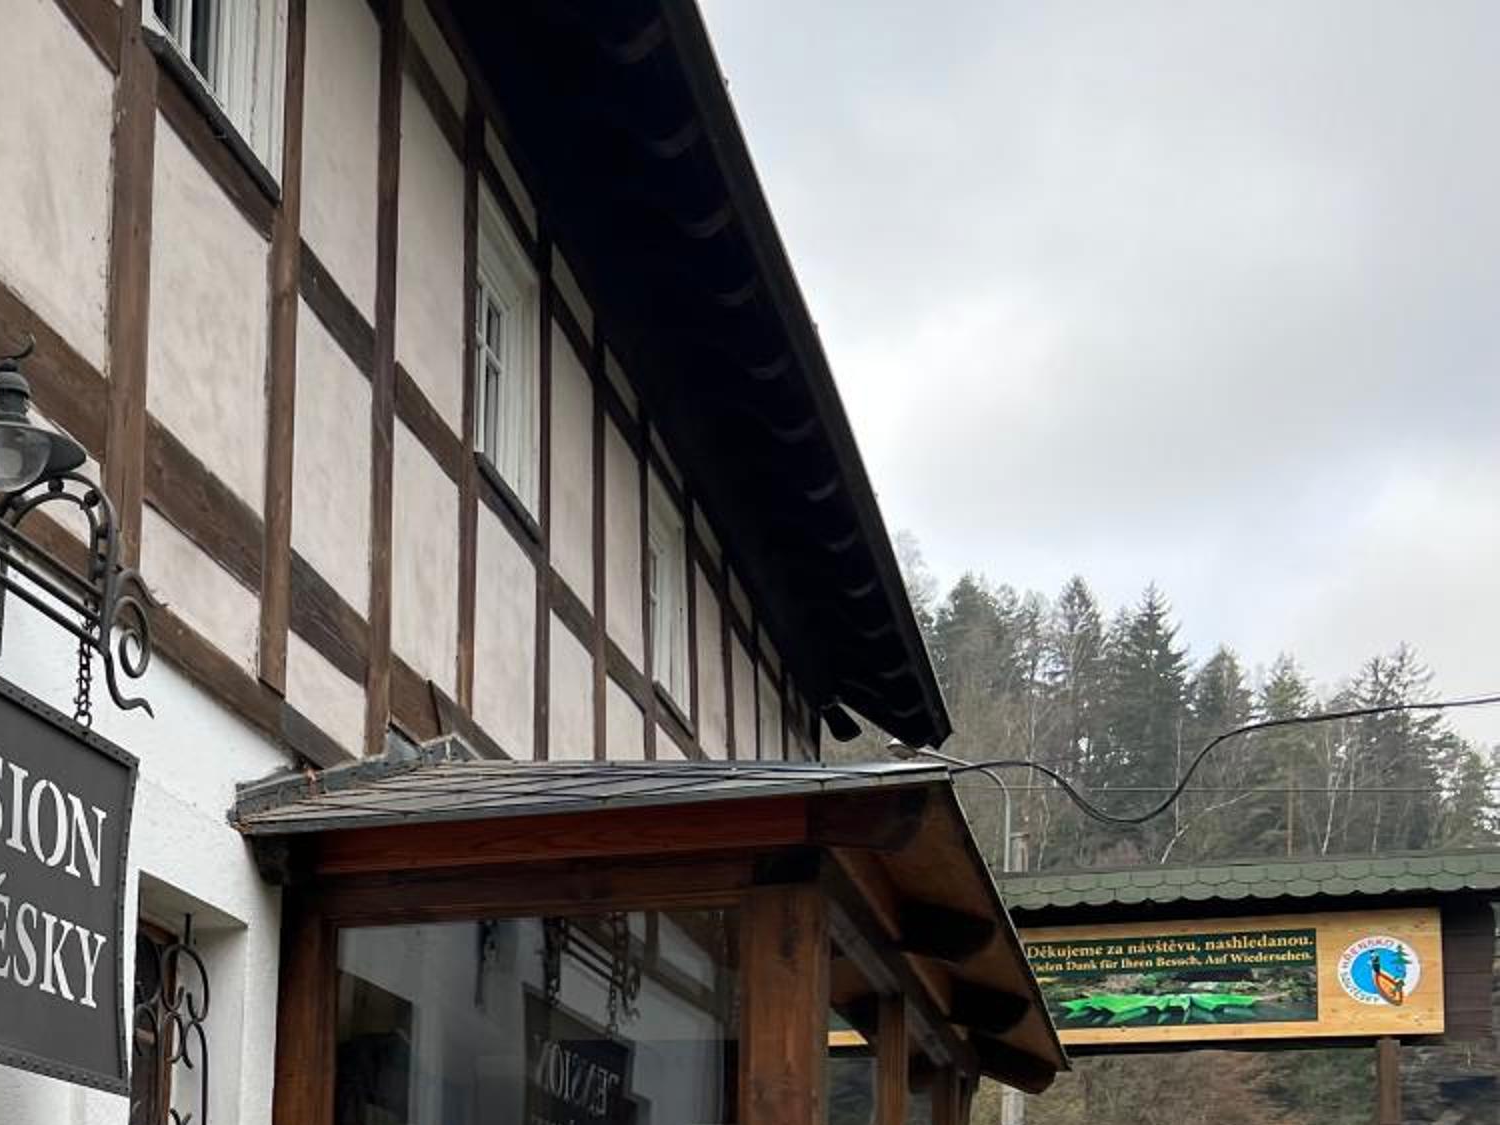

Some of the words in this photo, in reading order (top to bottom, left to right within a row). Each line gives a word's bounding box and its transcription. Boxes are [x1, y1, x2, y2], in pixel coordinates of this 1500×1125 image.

[1027, 944, 1103, 960] Děkujeme
[1107, 945, 1124, 955] za
[1205, 933, 1314, 951] nashledanou.
[1066, 959, 1098, 971] Dank
[1100, 958, 1119, 969] für
[1121, 957, 1153, 969] Ihren
[1205, 954, 1229, 965] Auf
